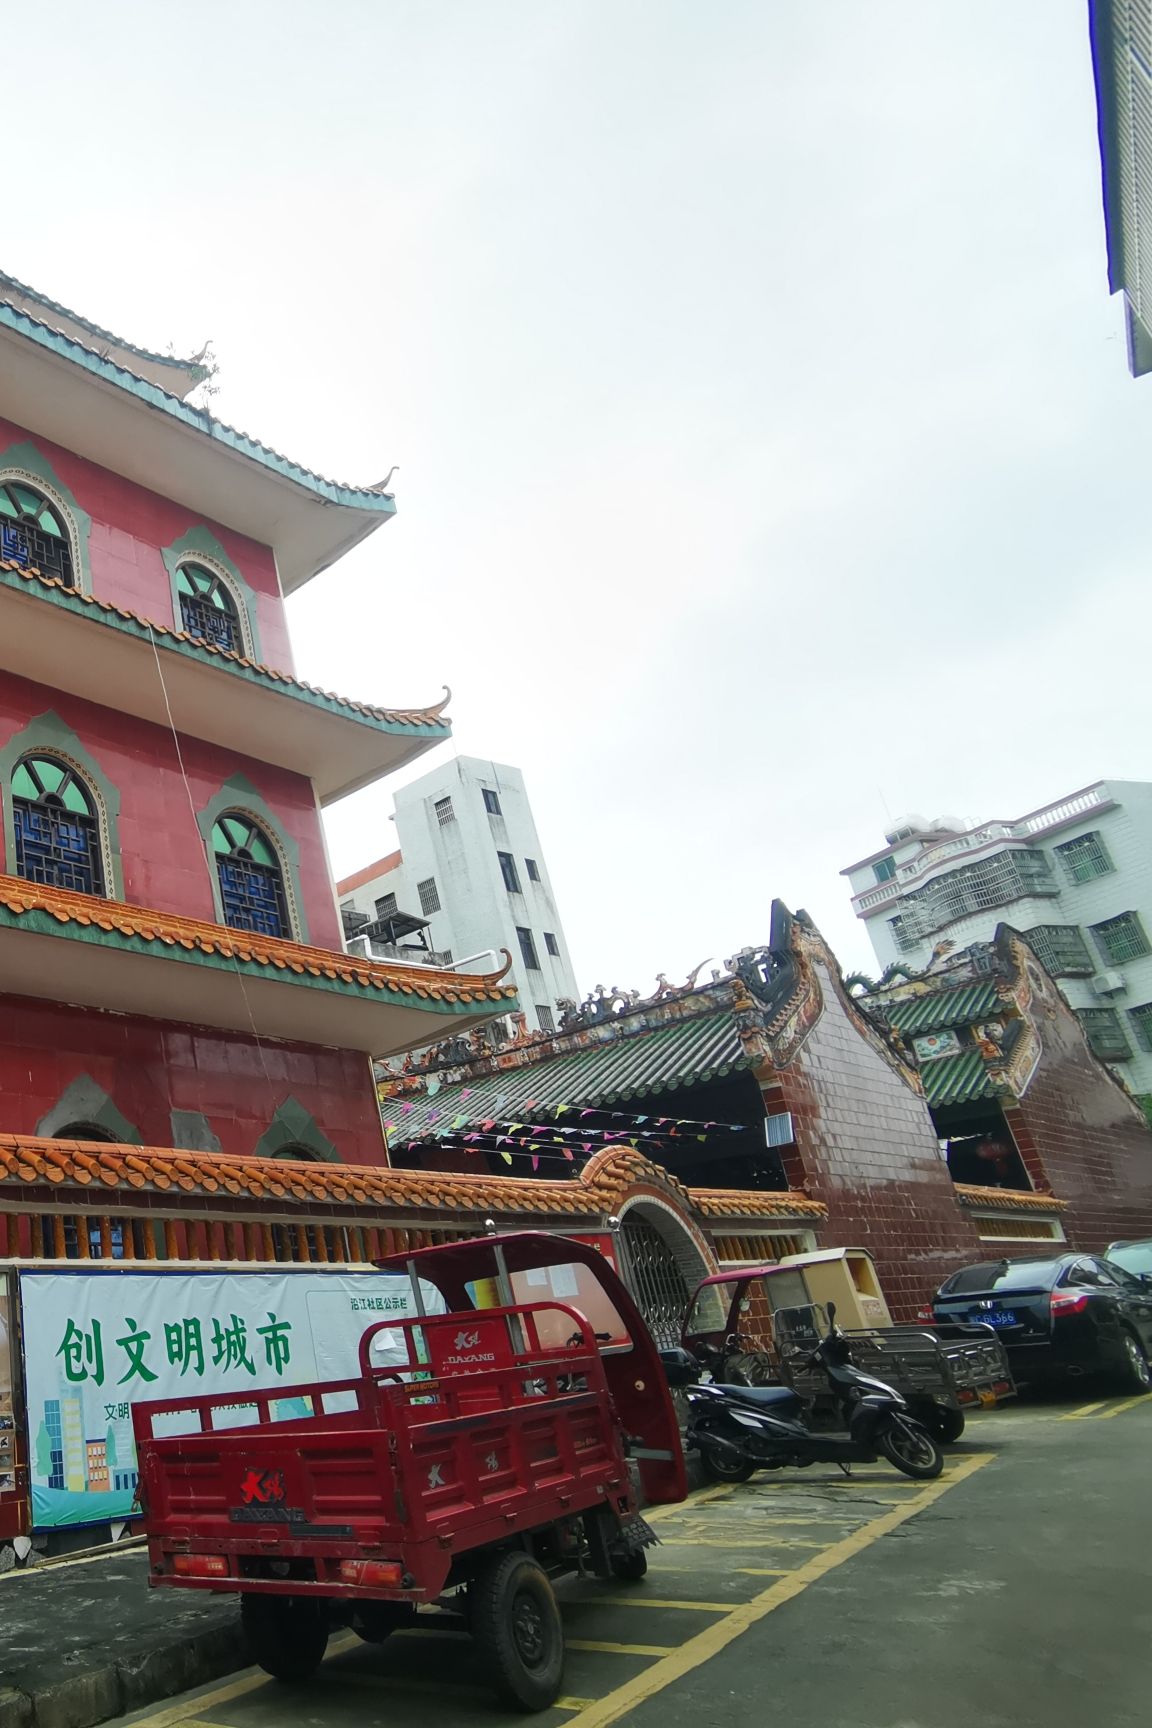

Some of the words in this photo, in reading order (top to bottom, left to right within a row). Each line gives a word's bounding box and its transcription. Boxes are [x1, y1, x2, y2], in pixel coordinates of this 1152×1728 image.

[350, 1297, 408, 1311] 沿江社区公示栏
[55, 1311, 292, 1387] 创文明城市
[448, 1353, 495, 1364] DAYANG
